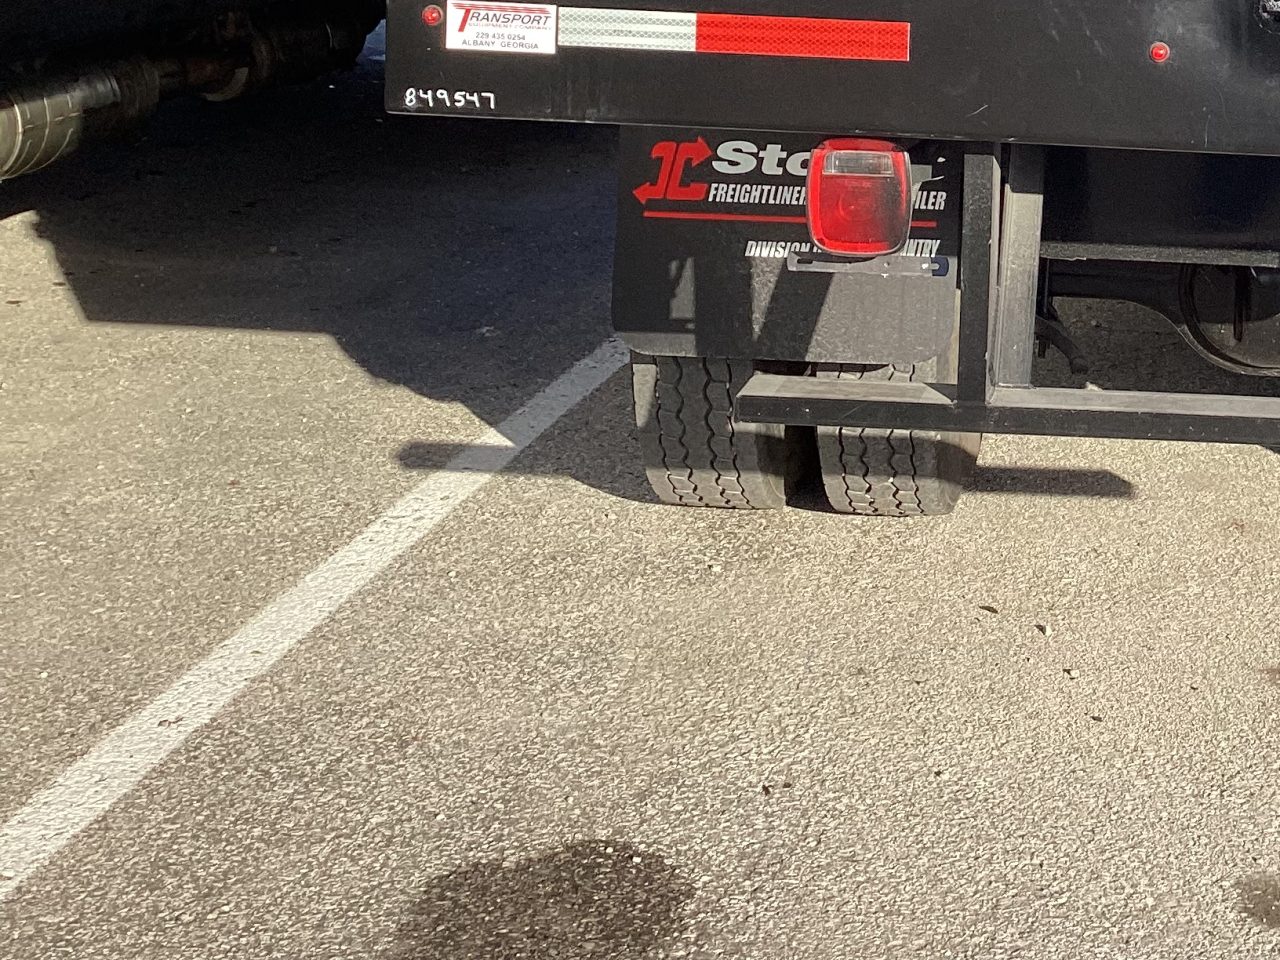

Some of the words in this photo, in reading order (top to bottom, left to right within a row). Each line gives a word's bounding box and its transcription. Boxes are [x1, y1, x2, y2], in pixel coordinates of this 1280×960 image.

[452, 3, 552, 33] TRANSPORT
[462, 39, 496, 48] ALBANY
[500, 41, 539, 50] GEORGIA
[476, 32, 490, 40] 229
[404, 87, 497, 110] 849547
